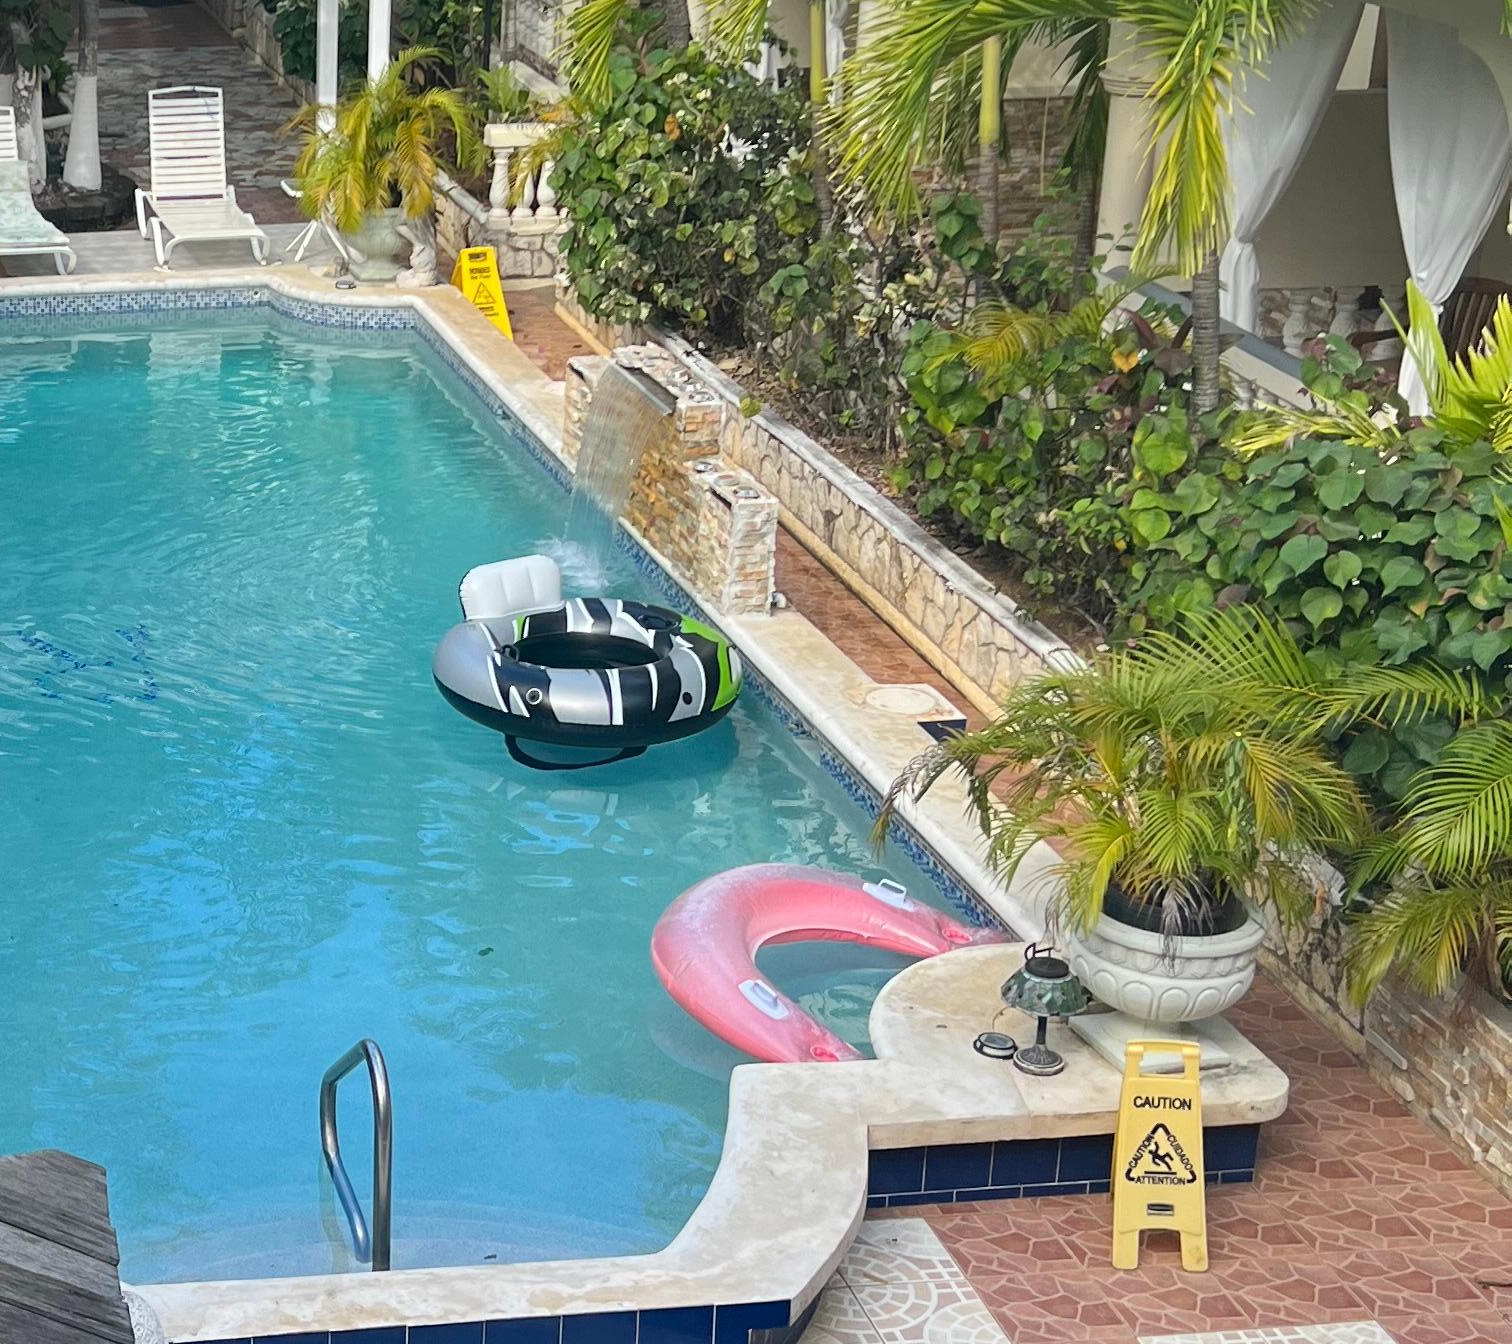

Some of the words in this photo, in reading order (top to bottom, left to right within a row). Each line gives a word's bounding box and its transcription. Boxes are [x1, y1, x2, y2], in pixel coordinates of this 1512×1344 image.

[1133, 1095, 1192, 1111] CAUTION
[1129, 1134, 1154, 1169] CAUTION
[1167, 1135, 1194, 1171] CUIDADO
[1135, 1176, 1186, 1186] ATTENTION
